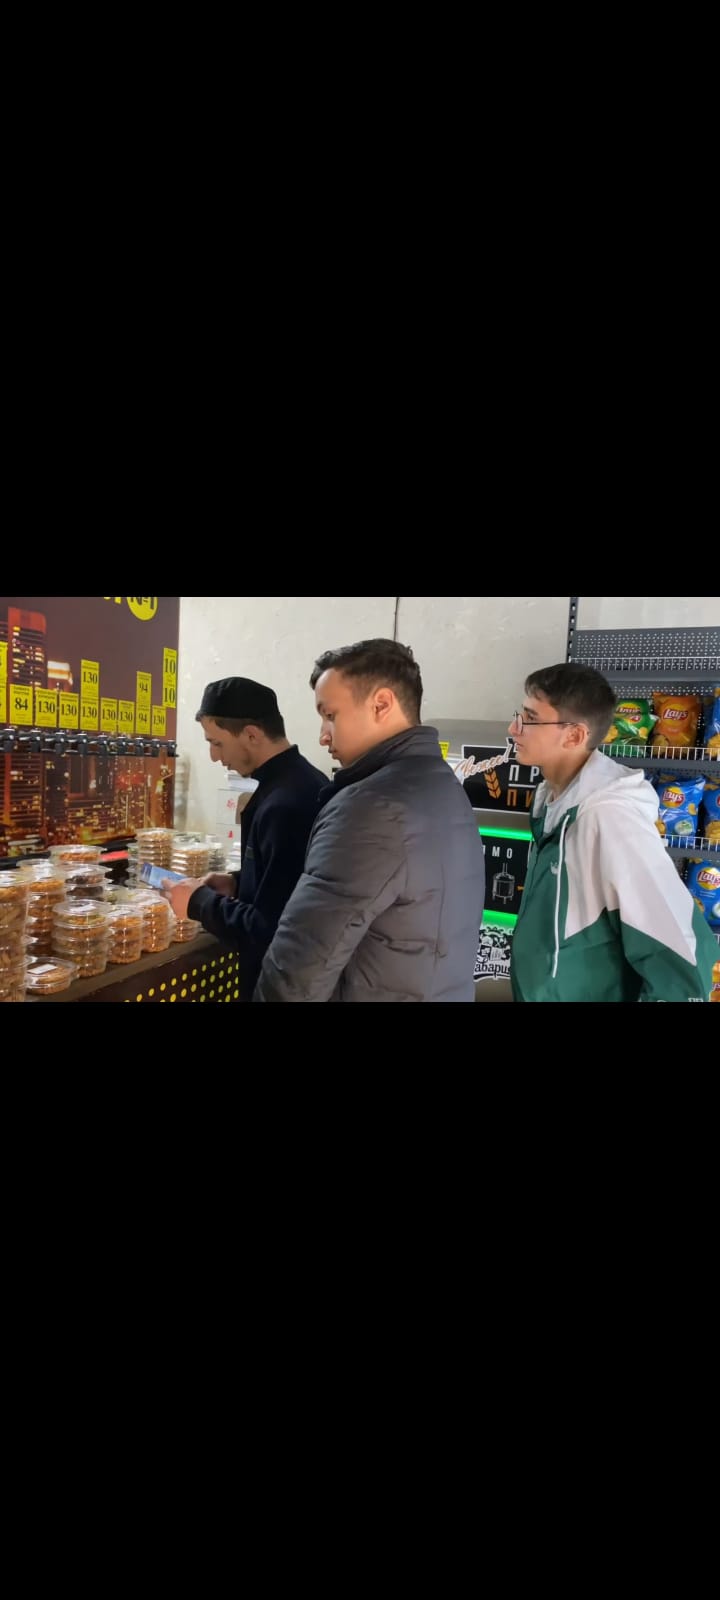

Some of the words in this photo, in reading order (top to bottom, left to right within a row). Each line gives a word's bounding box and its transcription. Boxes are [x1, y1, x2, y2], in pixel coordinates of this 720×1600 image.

[83, 671, 98, 684] 130
[139, 682, 148, 693] 94
[15, 698, 29, 710] 84
[38, 701, 56, 713] 130
[61, 703, 77, 716] 130
[82, 706, 97, 719] 130
[102, 708, 117, 721] 130
[120, 711, 133, 722] 130
[138, 712, 147, 724] 94
[153, 715, 165, 726] 130
